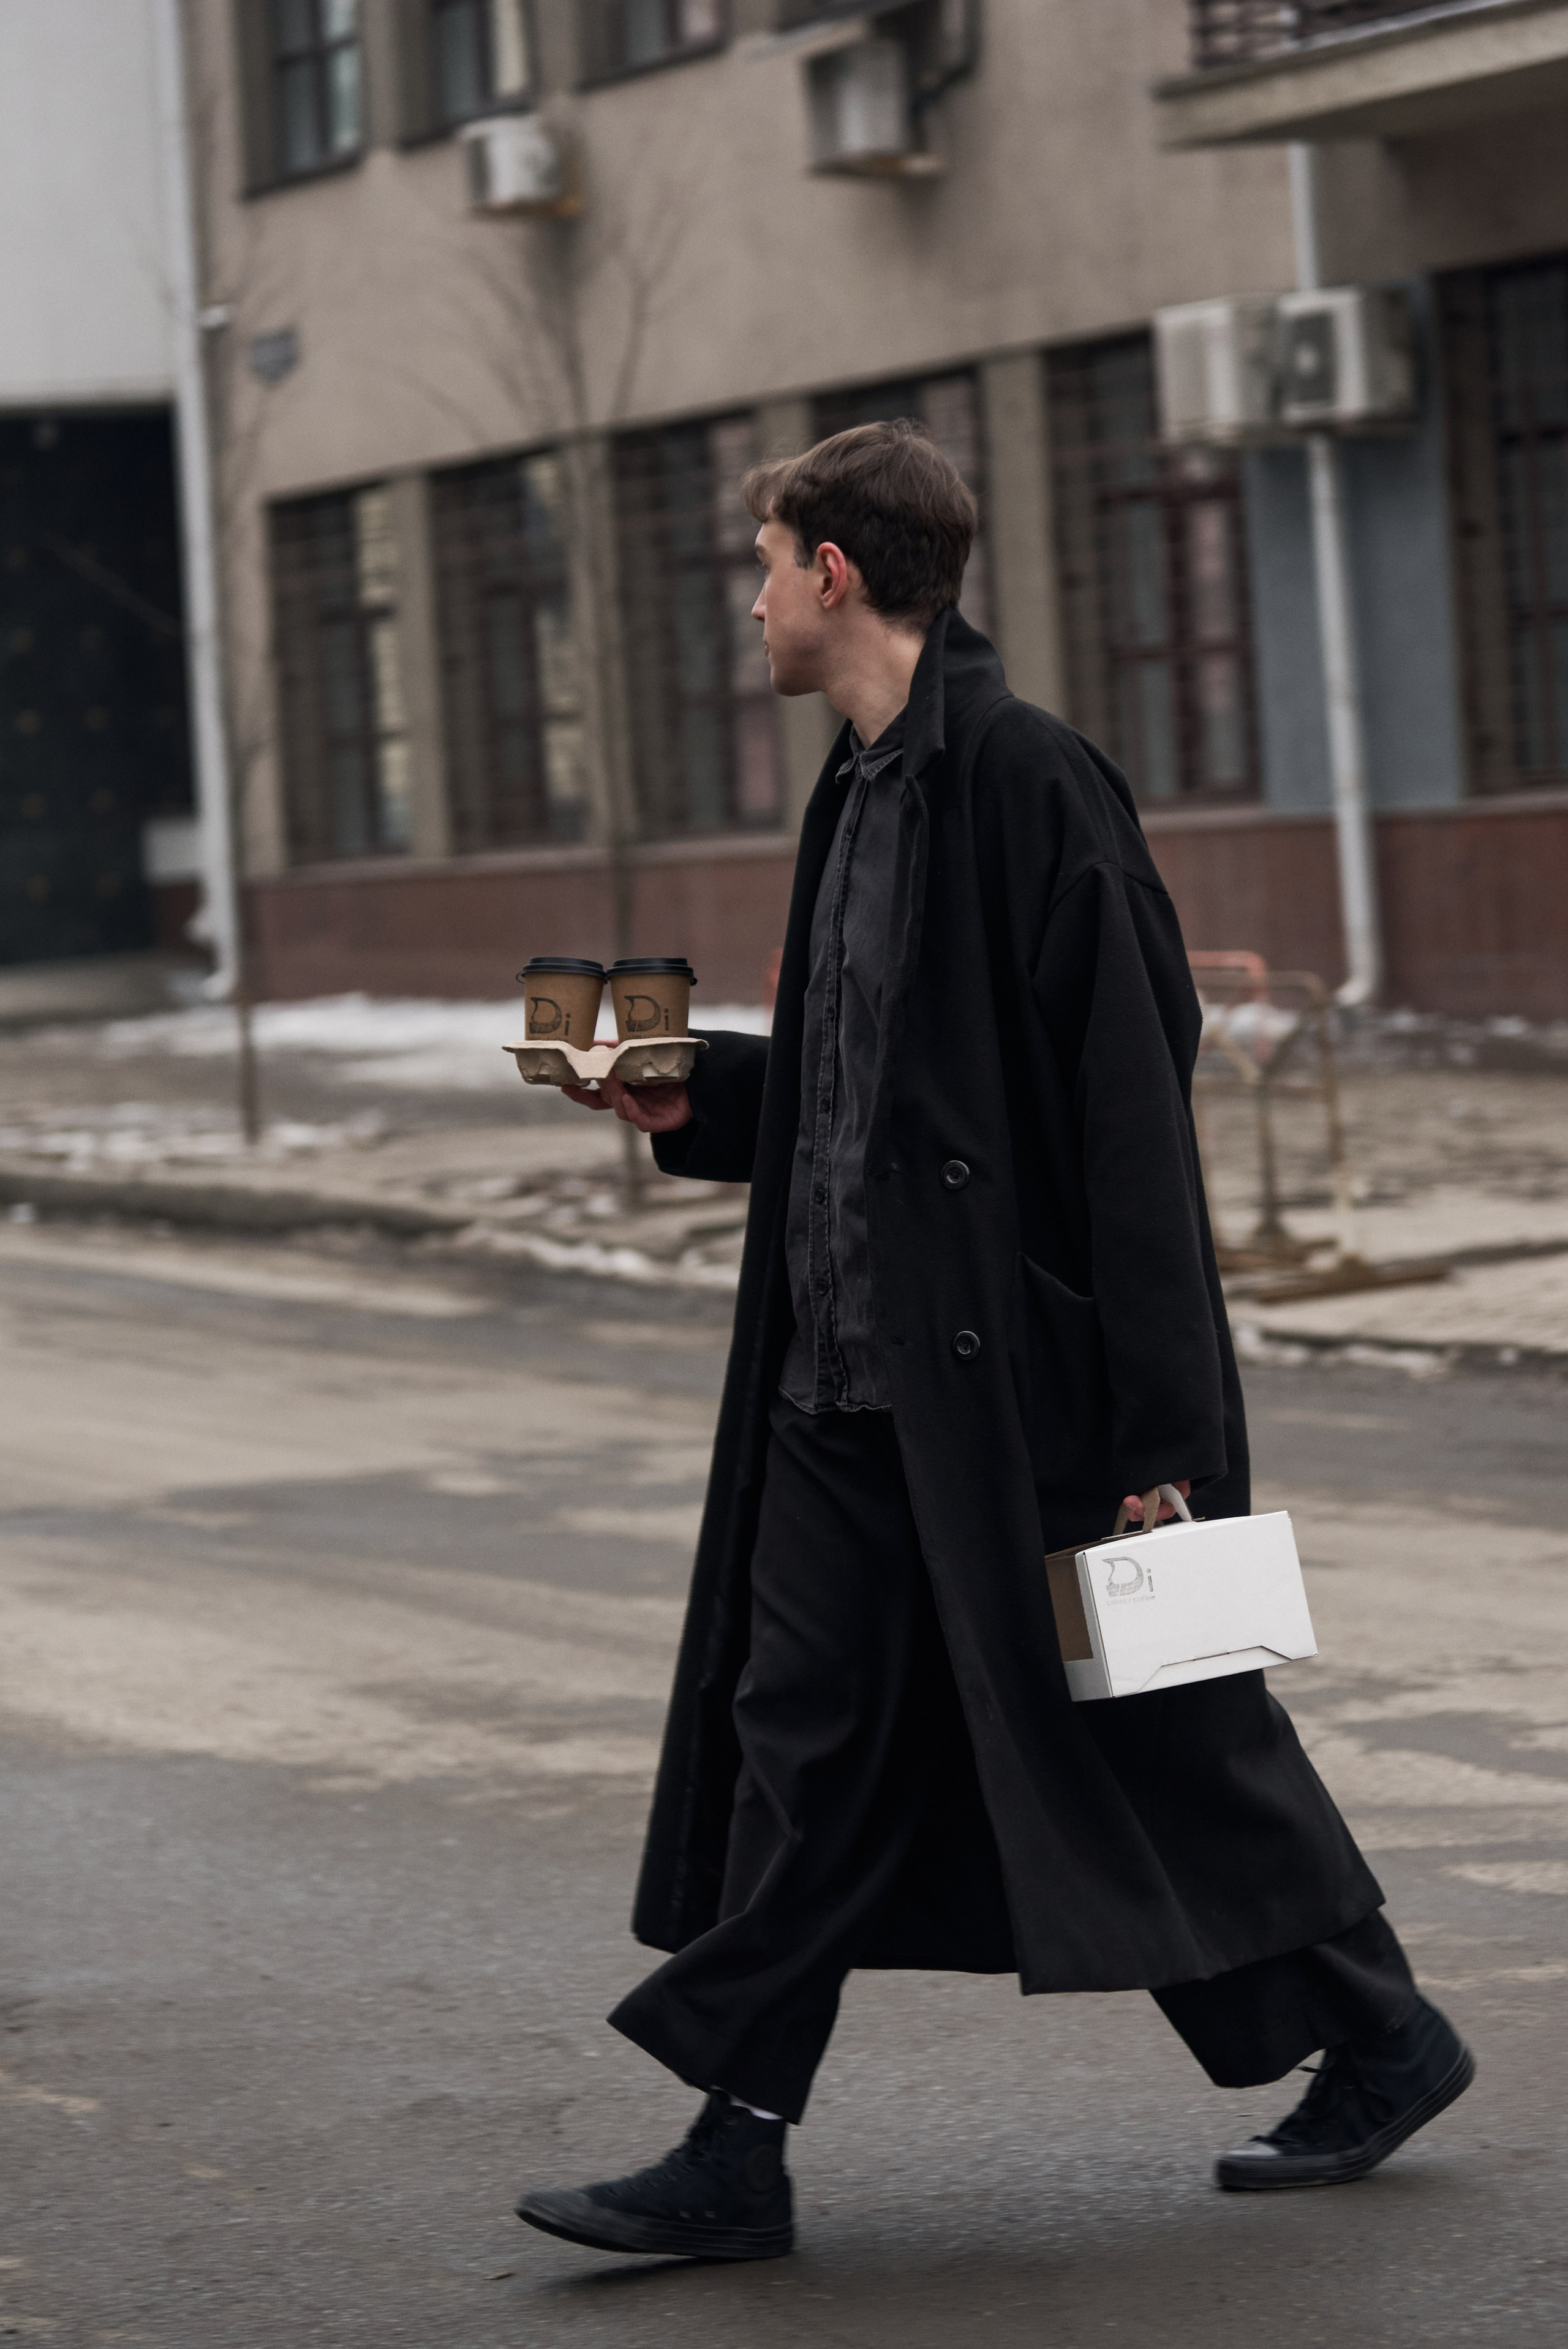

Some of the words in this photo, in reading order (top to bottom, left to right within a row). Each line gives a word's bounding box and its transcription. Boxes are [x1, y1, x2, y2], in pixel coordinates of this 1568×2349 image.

[529, 997, 571, 1036] Di
[624, 995, 669, 1031] Di
[1102, 1556, 1154, 1597] Di
